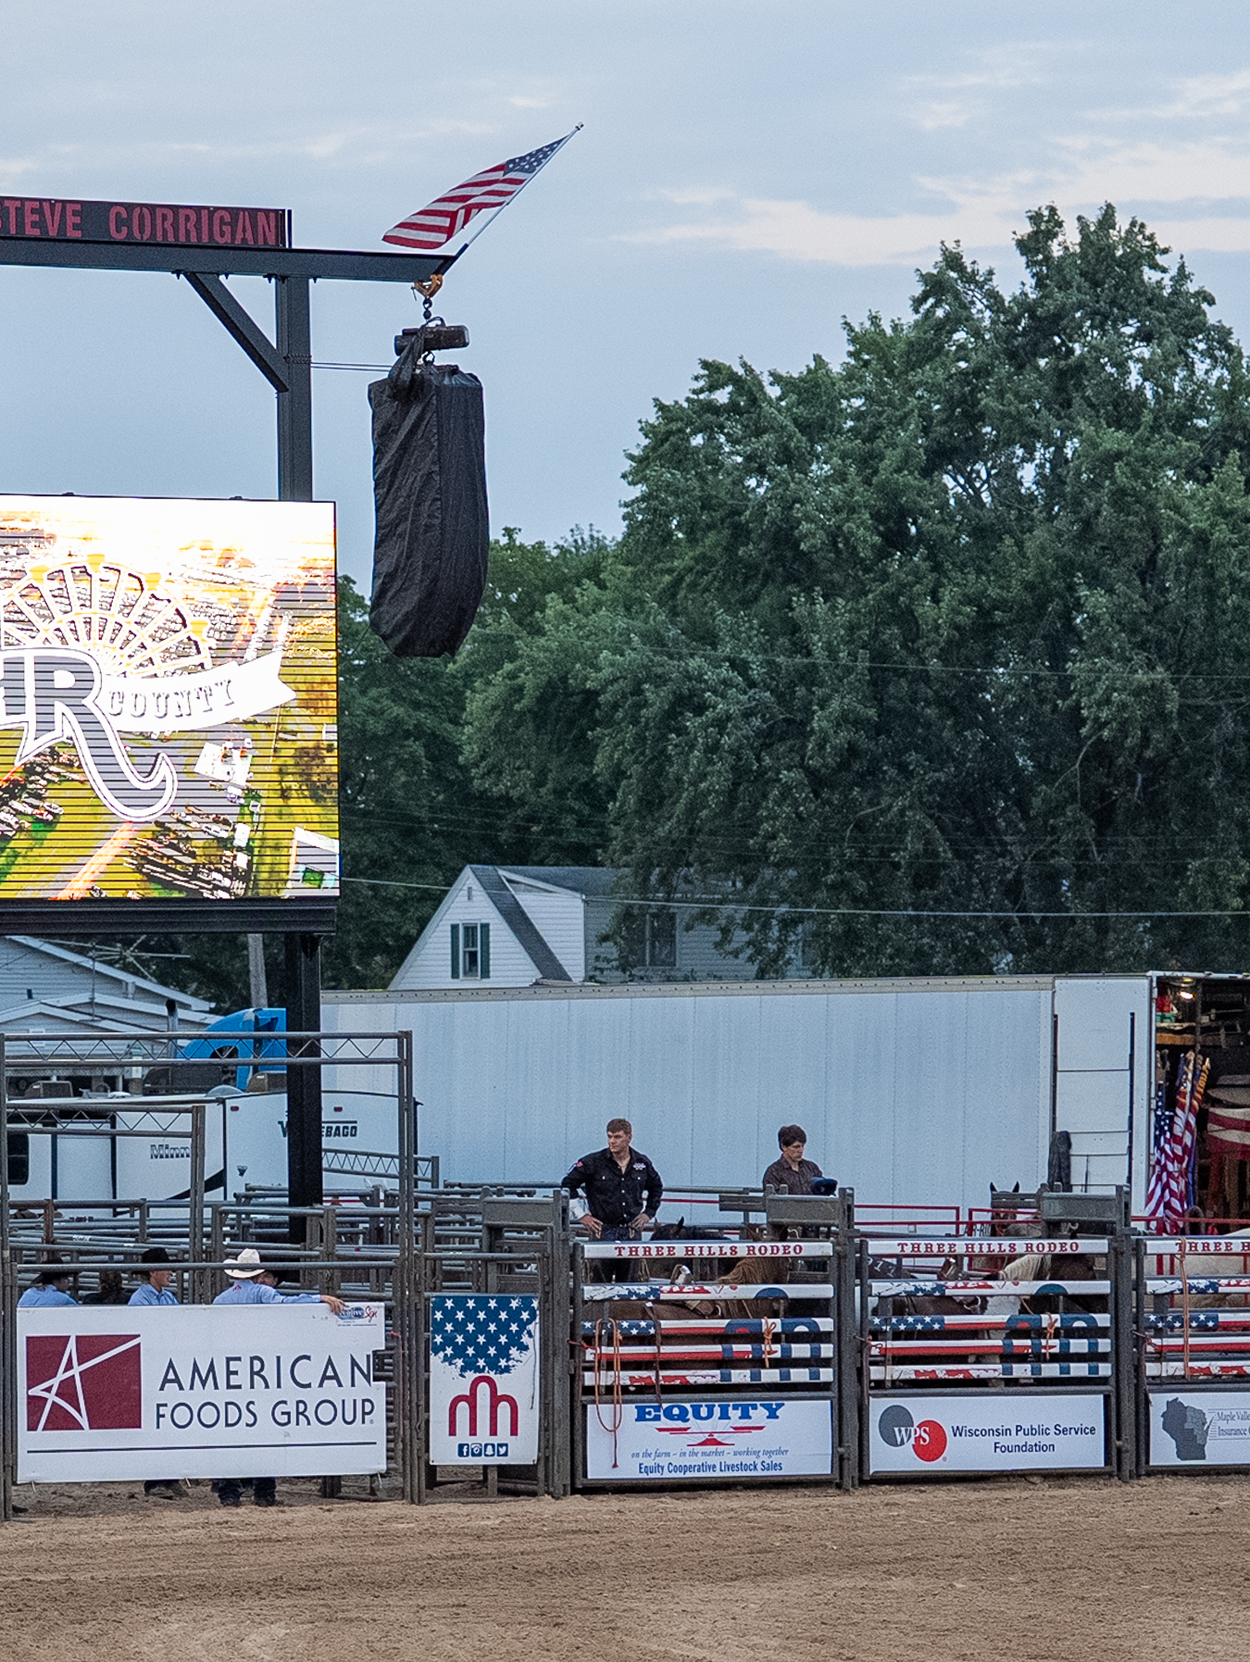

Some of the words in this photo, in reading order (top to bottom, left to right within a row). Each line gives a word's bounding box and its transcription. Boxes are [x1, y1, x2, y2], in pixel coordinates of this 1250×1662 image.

[109, 204, 278, 247] CORRIGAN
[107, 677, 235, 717] COUNTY
[615, 1246, 676, 1257] THREE
[684, 1245, 738, 1256] HILLS
[746, 1244, 803, 1255] RODEO
[897, 1242, 957, 1254] THREE
[964, 1242, 1017, 1254] HILLS
[1025, 1241, 1079, 1253] RODEO
[1175, 1241, 1233, 1252] THREE
[158, 1353, 372, 1392] AMERICAN
[155, 1400, 258, 1430] FOODS
[271, 1398, 375, 1428] GROUP
[634, 1403, 786, 1422] EQUITY
[893, 1426, 931, 1446] WPS
[951, 1425, 1012, 1437] Wisconsin
[1015, 1424, 1050, 1436] Public
[1053, 1423, 1096, 1435] Service
[701, 1447, 725, 1457] market
[733, 1447, 761, 1459] working
[762, 1446, 789, 1459] together
[993, 1441, 1055, 1453] Foundation
[638, 1462, 664, 1476] Equity
[667, 1461, 717, 1475] Cooperative
[719, 1460, 758, 1472] Livestock
[760, 1460, 783, 1472] Sales
